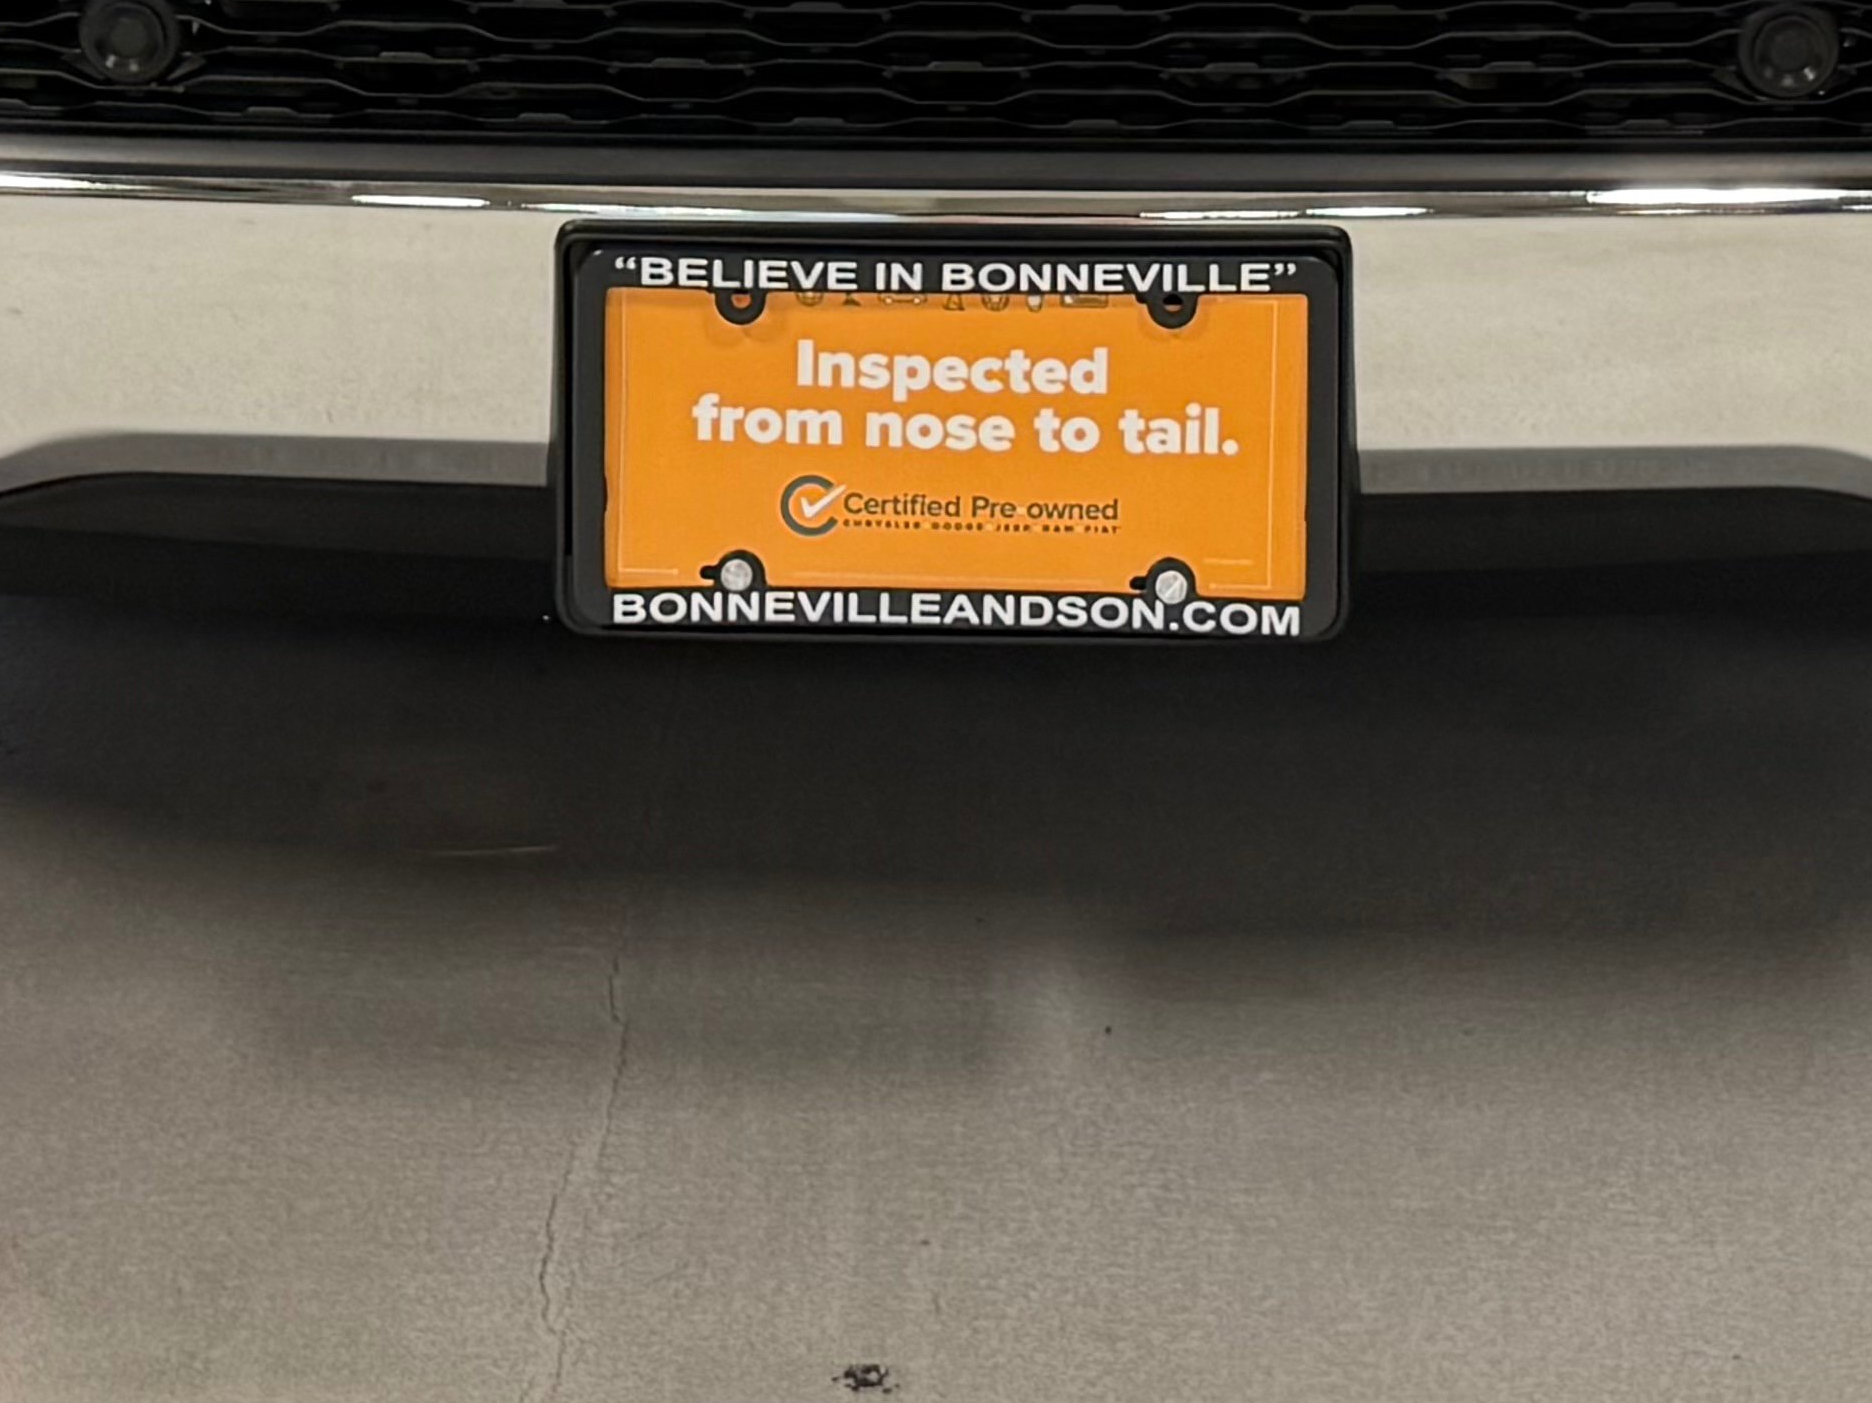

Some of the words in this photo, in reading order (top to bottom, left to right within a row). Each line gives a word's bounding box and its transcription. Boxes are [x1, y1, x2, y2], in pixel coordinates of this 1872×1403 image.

[875, 262, 924, 291] IN
[797, 339, 1109, 403] Inspected
[691, 393, 843, 445] from
[865, 401, 1016, 452] nose
[1034, 408, 1101, 453] to
[1118, 403, 1240, 456] tail.
[843, 492, 961, 518] Certified
[613, 591, 1301, 636] BONNEVILLEANDSON.COM
